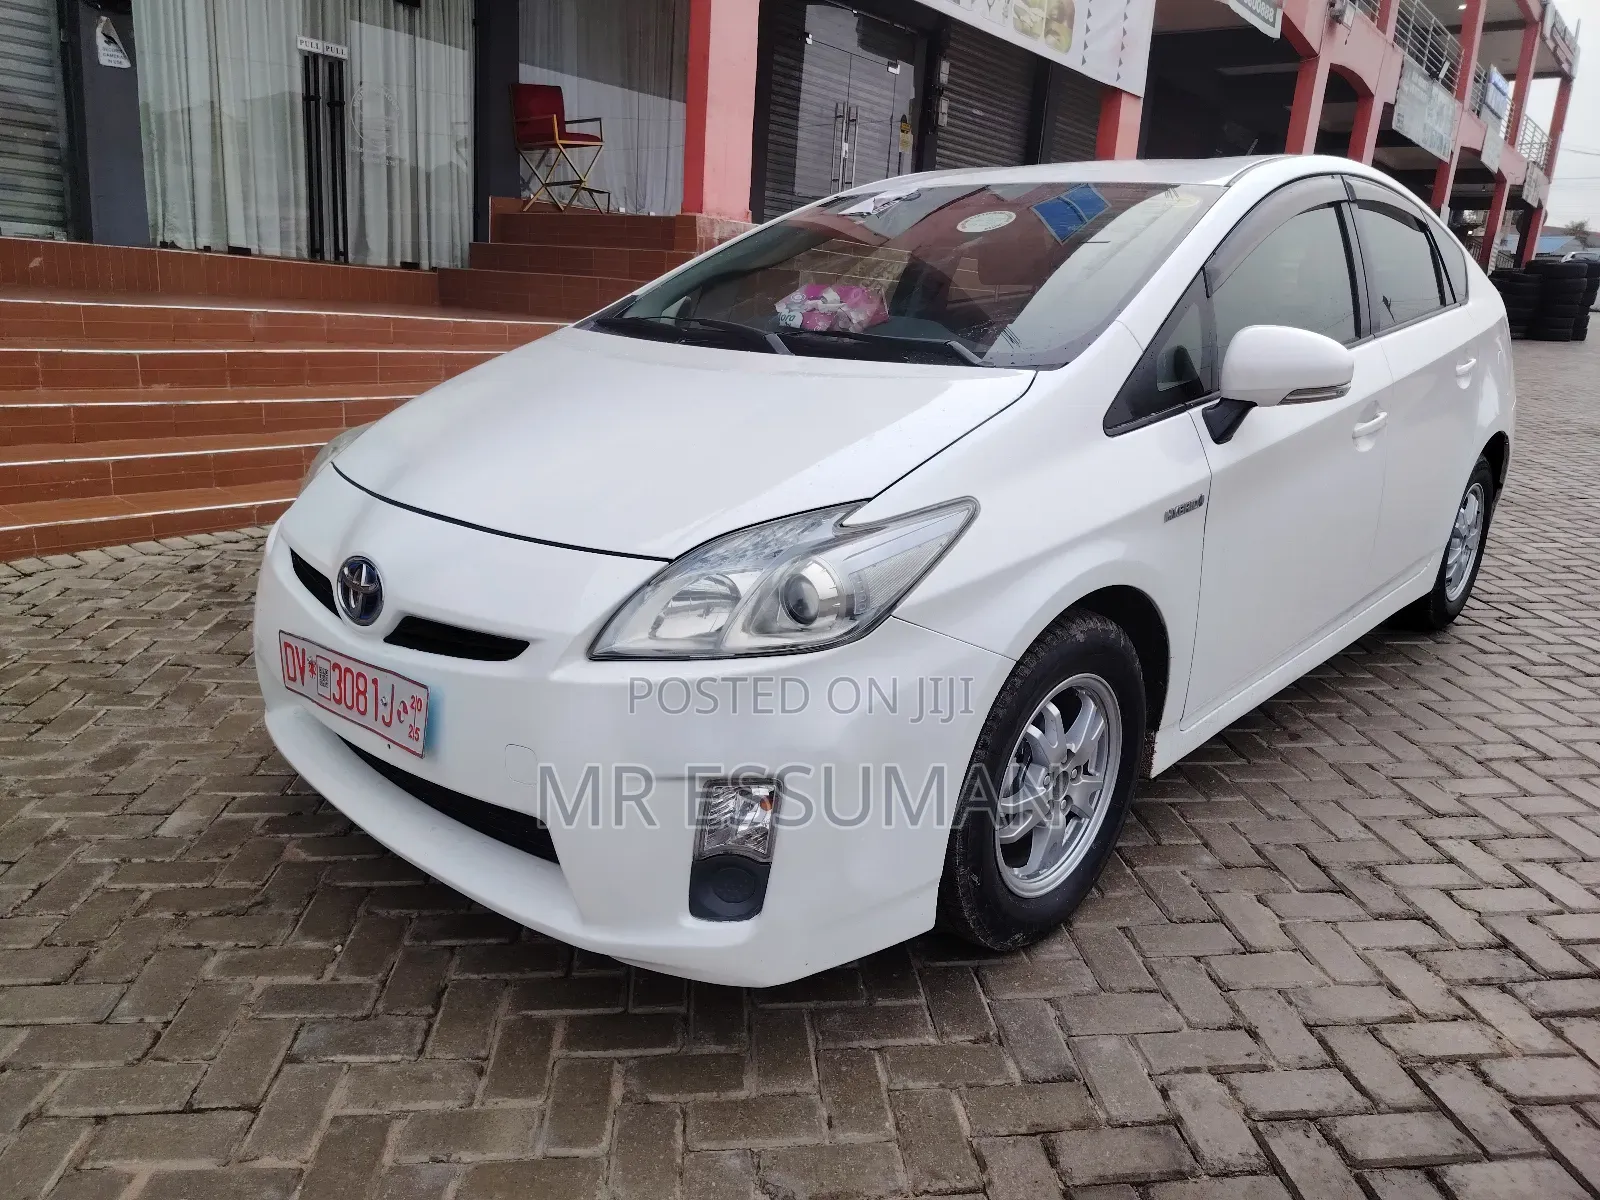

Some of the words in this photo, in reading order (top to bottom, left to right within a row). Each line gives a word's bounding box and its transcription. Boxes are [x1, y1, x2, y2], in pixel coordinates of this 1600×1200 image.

[299, 39, 321, 50] PULL
[325, 45, 346, 56] PULL
[284, 641, 306, 687] DV
[408, 723, 421, 742] 25
